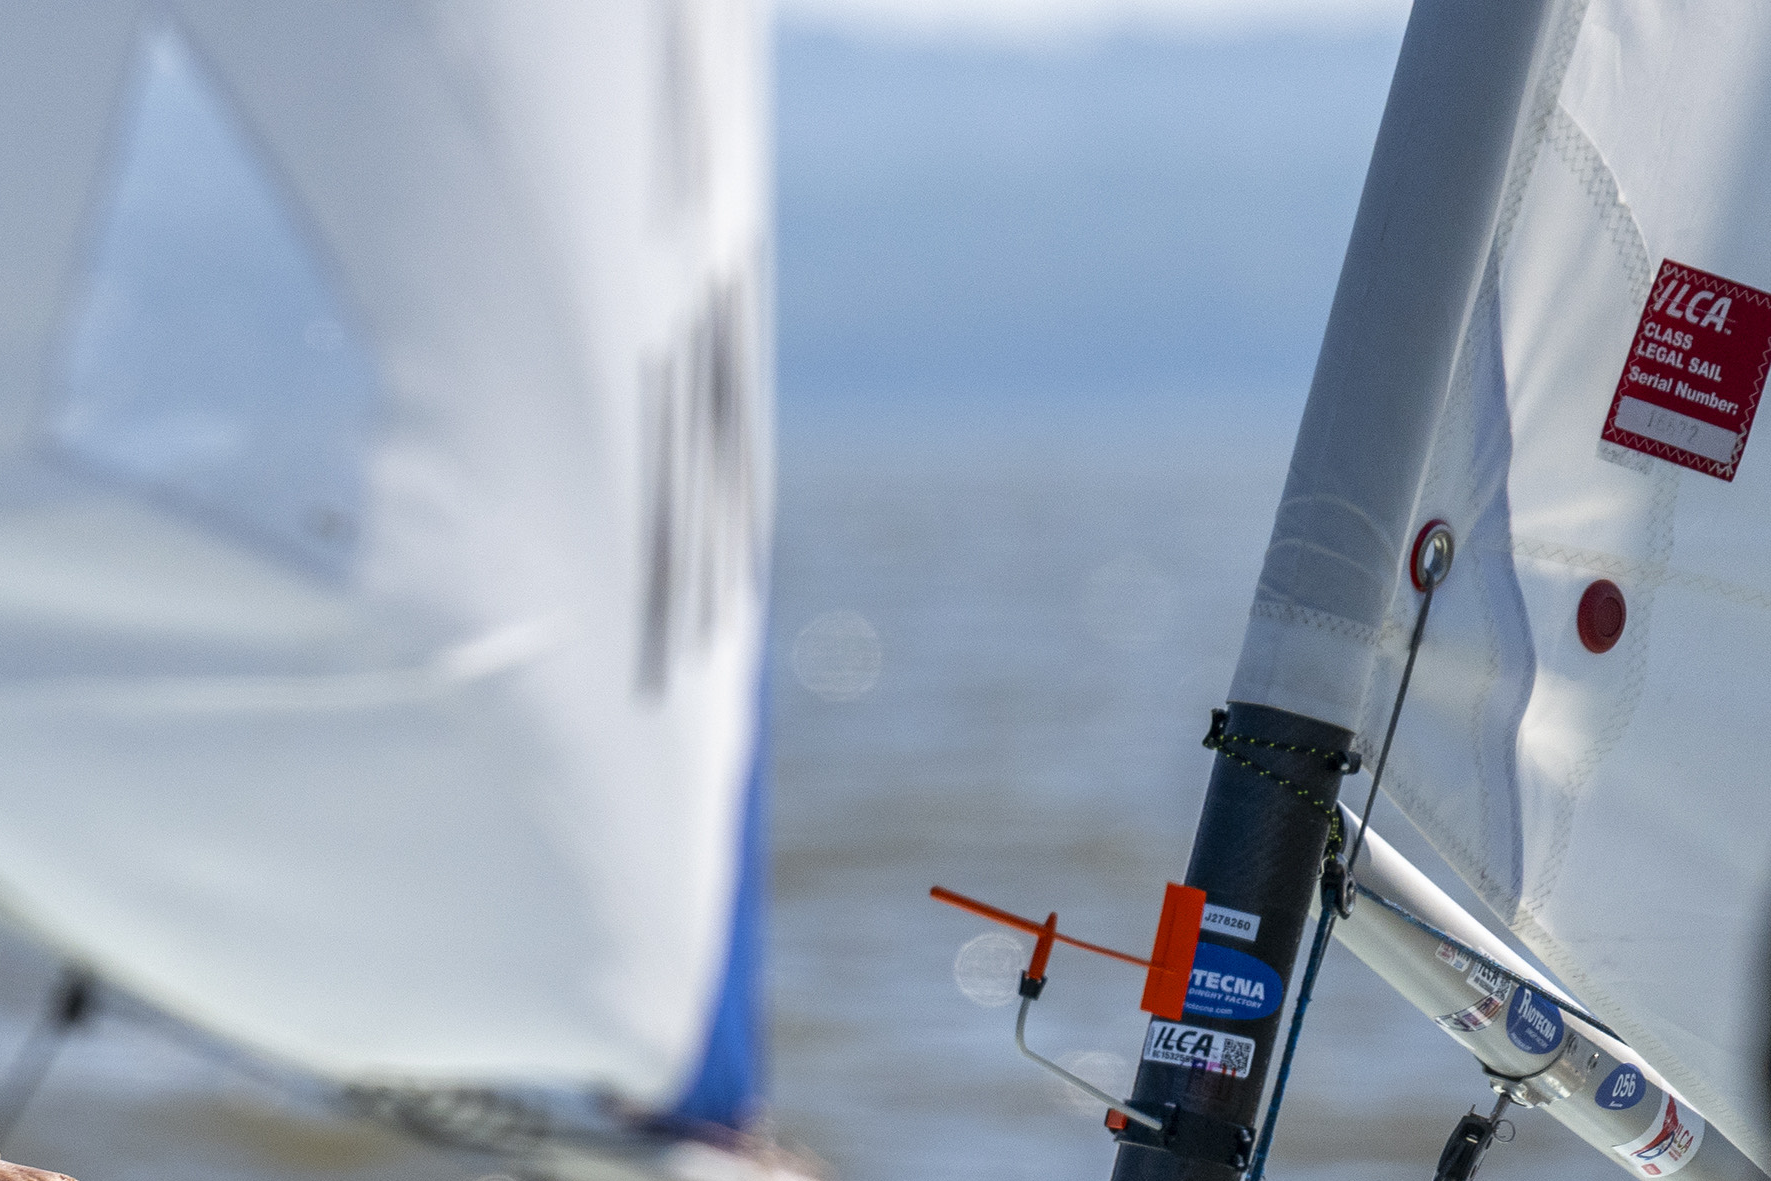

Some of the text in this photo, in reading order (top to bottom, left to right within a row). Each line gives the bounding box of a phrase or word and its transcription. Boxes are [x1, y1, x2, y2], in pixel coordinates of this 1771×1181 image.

[1653, 279, 1733, 333] ILCA
[1644, 321, 1694, 350] CLASS
[1636, 340, 1722, 382] LEGAL SAIL
[1628, 365, 1740, 416] Serial Number:
[1188, 968, 1266, 1001] TECNA
[1188, 987, 1263, 1009] DINGHY FACTORY
[1153, 1025, 1215, 1057] ILCA
[1612, 1073, 1637, 1097] 056
